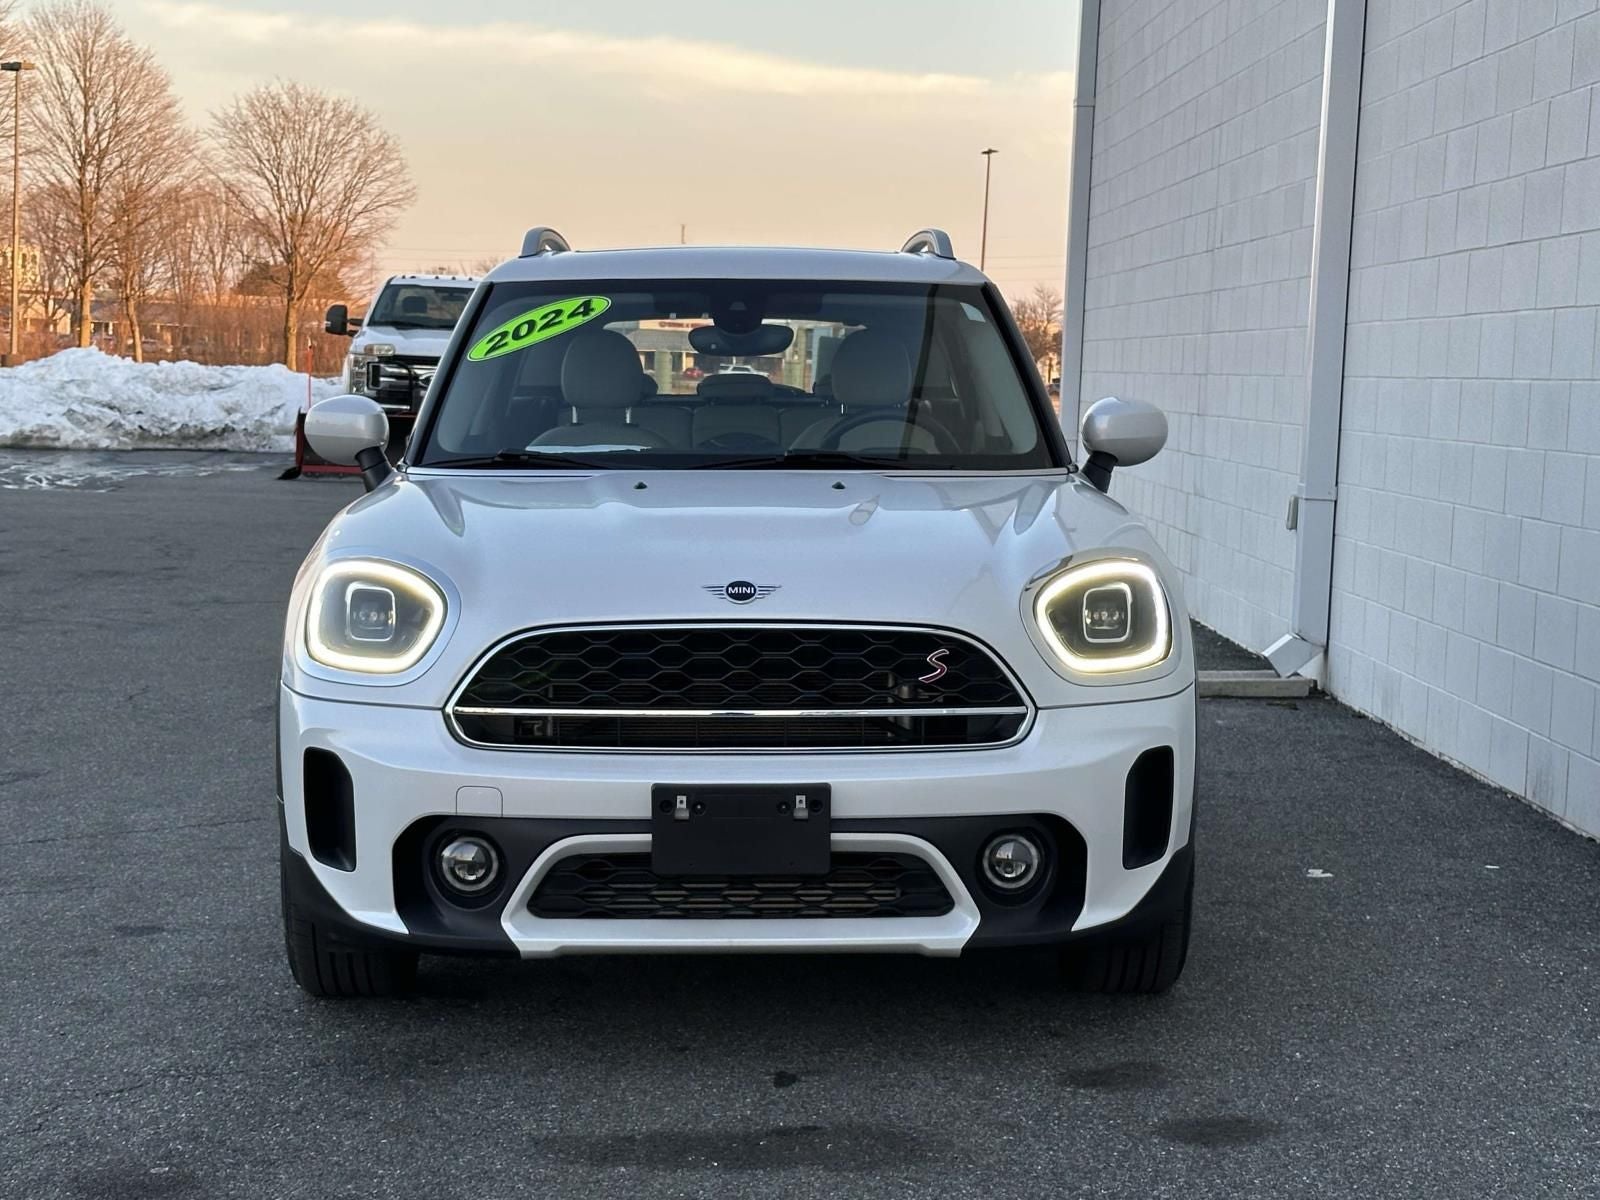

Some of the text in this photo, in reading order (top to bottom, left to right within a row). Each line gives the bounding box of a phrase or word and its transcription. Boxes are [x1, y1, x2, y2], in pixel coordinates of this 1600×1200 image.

[484, 299, 595, 356] 2024
[728, 586, 755, 594] MINI
[918, 648, 950, 684] S
